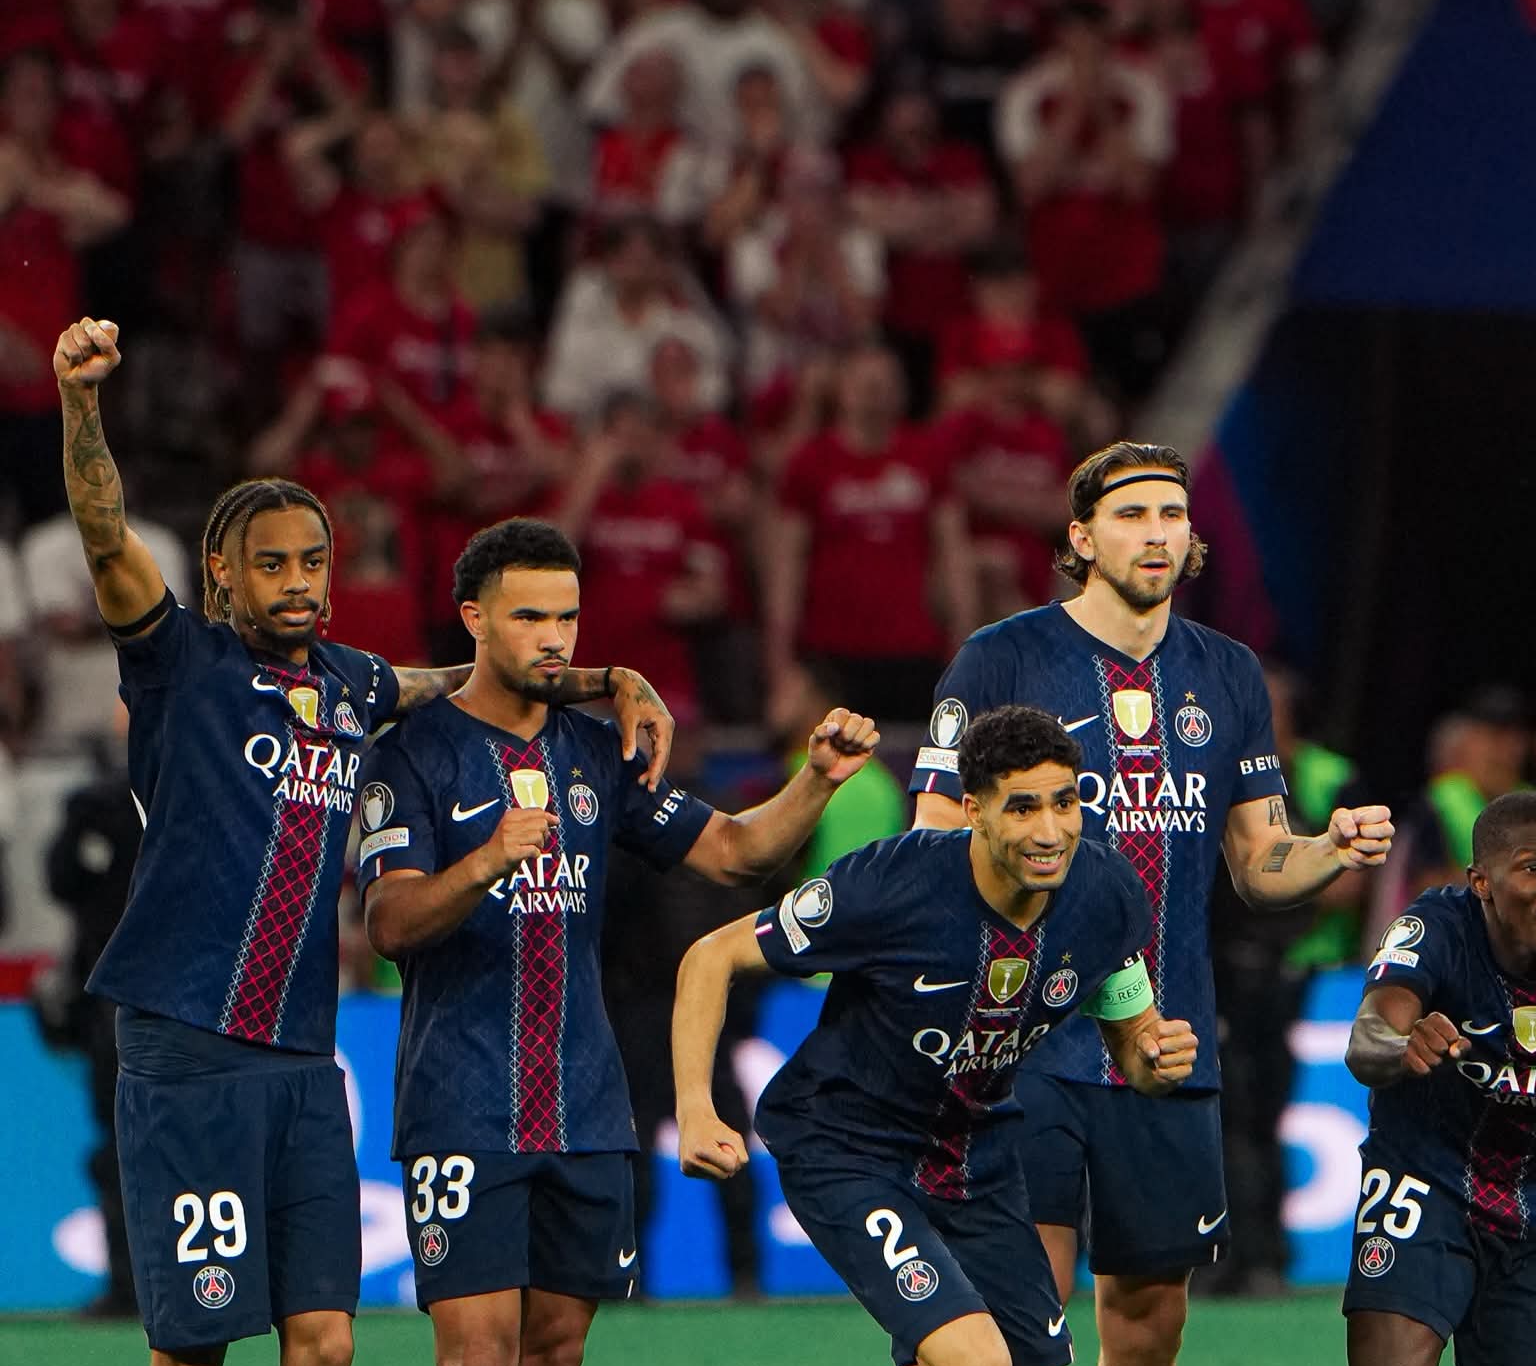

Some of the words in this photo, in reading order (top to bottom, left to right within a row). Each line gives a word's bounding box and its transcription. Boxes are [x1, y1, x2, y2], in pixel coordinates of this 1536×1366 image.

[244, 733, 360, 790] QATAR
[272, 776, 354, 814] AIRWAYS
[653, 788, 688, 826] BEY
[1077, 771, 1206, 816] QATAR
[1105, 809, 1206, 834] AIRWAYS
[508, 890, 587, 915] AIRWAYS
[411, 1154, 475, 1223] 33
[1357, 1168, 1431, 1240] 25
[173, 1191, 247, 1263] 29
[865, 1208, 919, 1270] 2
[198, 1266, 226, 1280] PARIS
